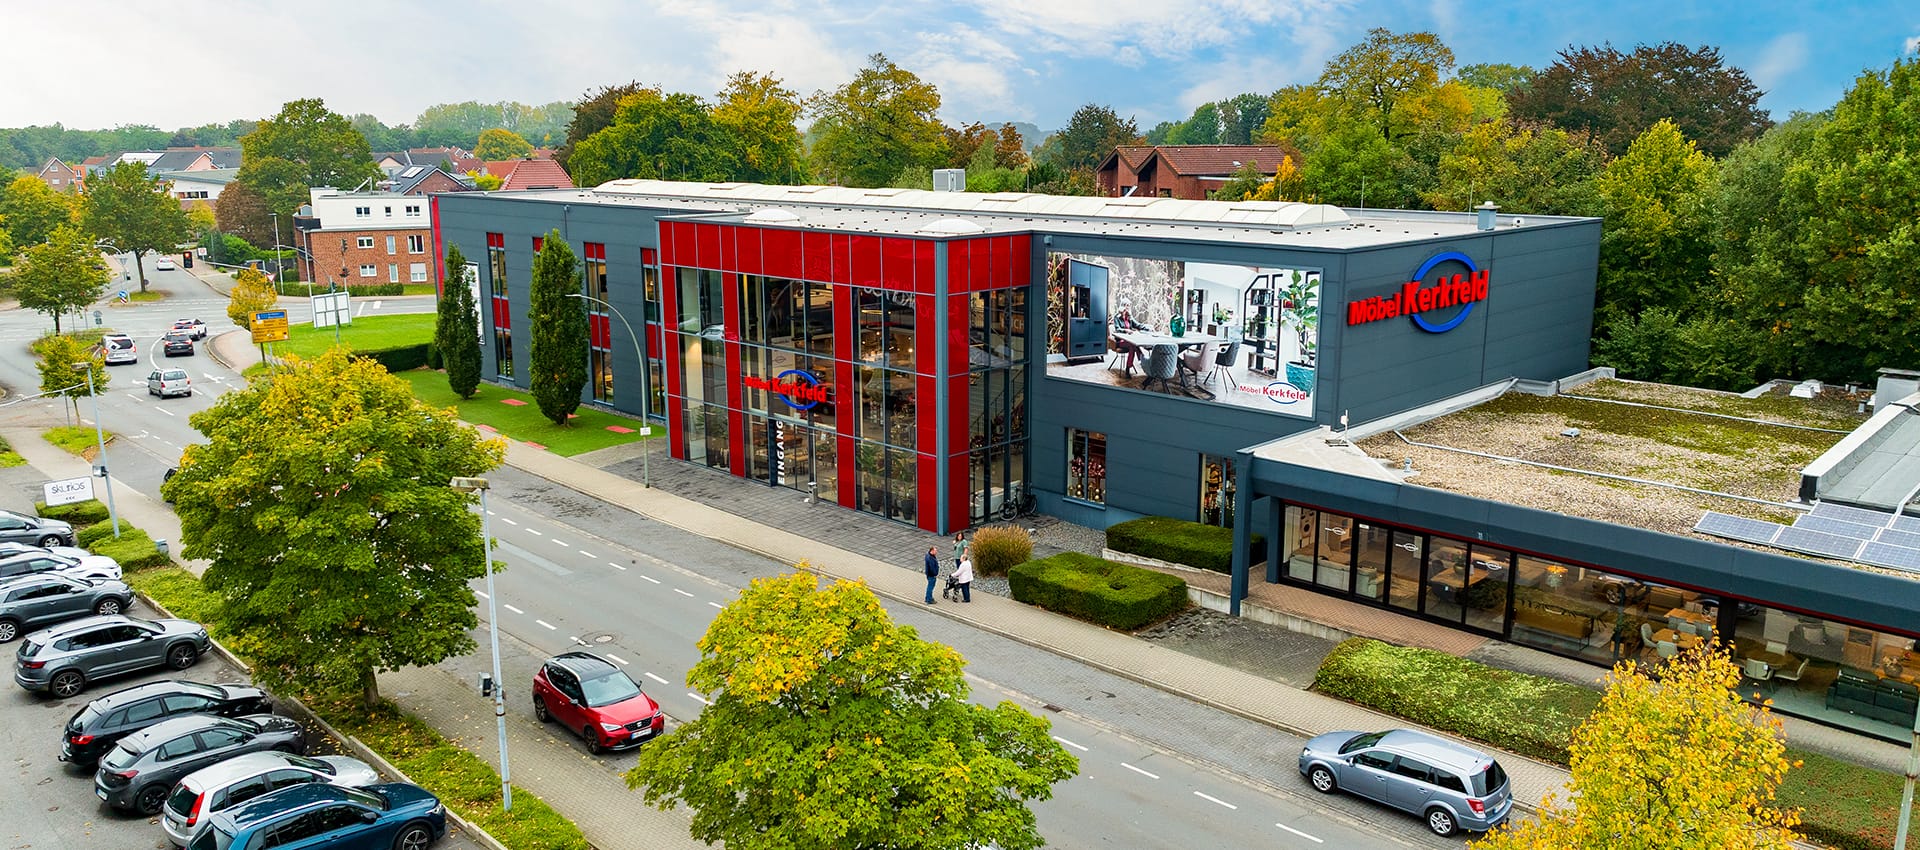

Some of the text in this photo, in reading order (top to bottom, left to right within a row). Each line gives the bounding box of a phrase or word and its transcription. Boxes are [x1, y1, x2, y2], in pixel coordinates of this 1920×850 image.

[1349, 270, 1489, 324] Möbel Kerkfeld
[771, 377, 827, 404] Kerkfeld
[1262, 386, 1306, 401] Kerkfeld
[776, 420, 786, 486] EINGANG
